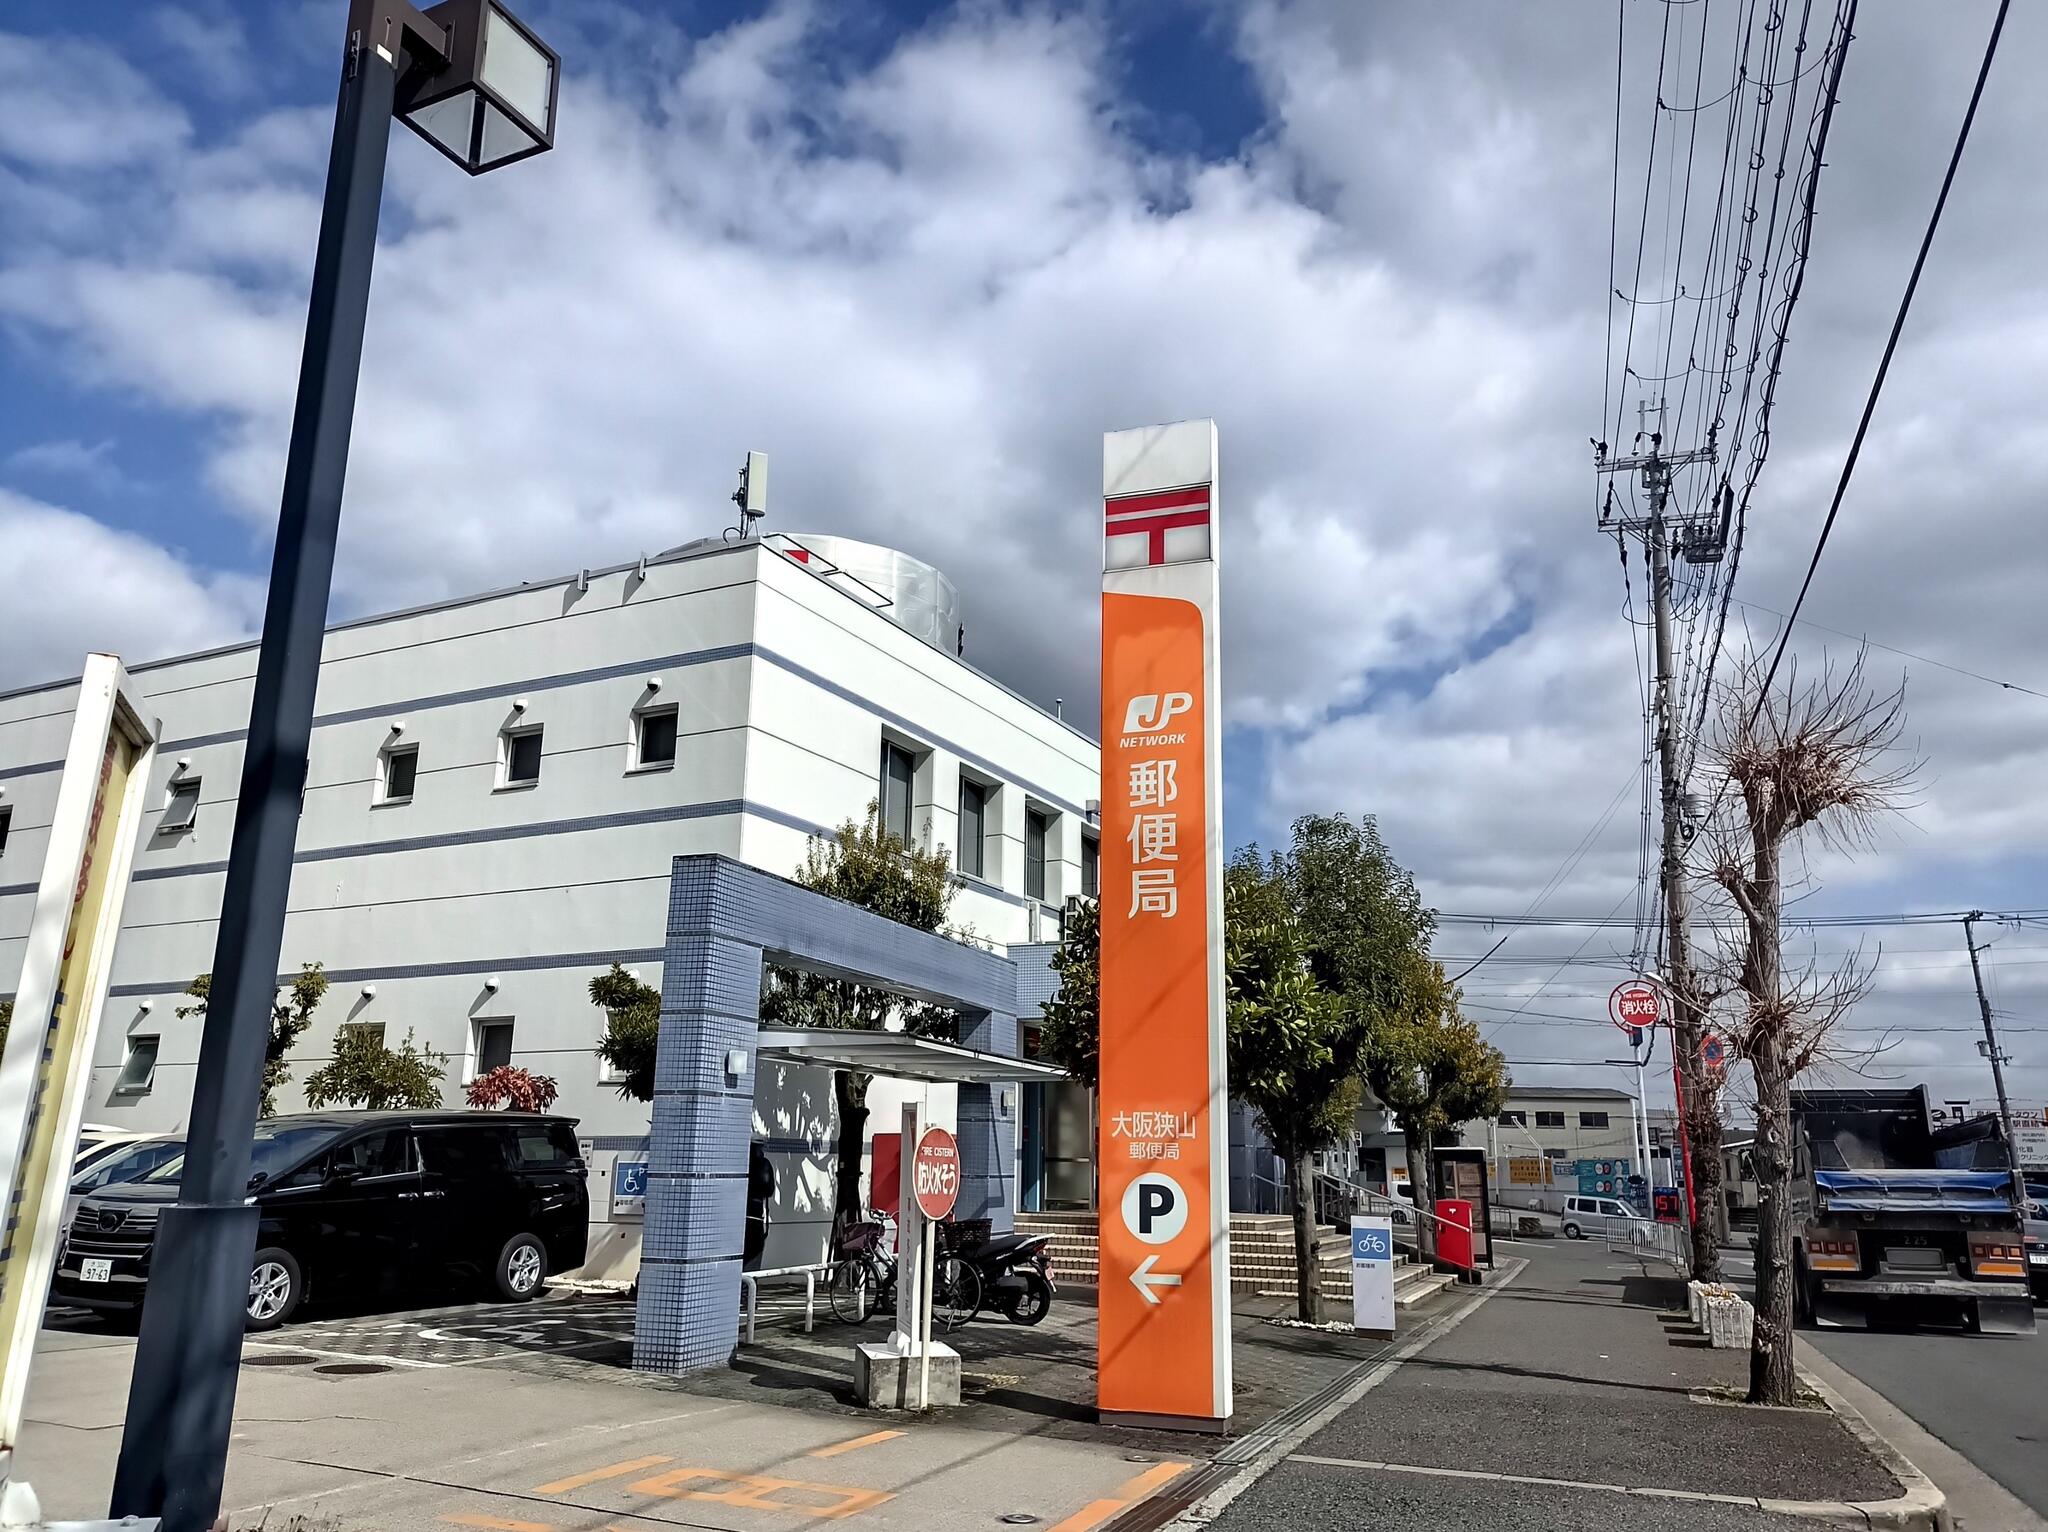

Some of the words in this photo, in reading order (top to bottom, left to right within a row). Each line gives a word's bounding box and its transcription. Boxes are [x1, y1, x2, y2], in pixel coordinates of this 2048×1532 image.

[1123, 692, 1193, 734] JP
[1120, 733, 1187, 749] NETWORK
[1127, 759, 1179, 920] 郵便局
[1621, 1000, 1656, 1015] 消火栓
[1111, 1110, 1196, 1139] 大阪狭山
[921, 1146, 933, 1156] FIRE
[934, 1147, 955, 1158] CISTERN
[1129, 1142, 1180, 1160] 郵便局
[638, 1167, 645, 1177] P
[918, 1162, 956, 1195] 防火水そう
[1138, 1183, 1175, 1234] P
[1655, 1195, 1679, 1211] 157
[85, 1268, 108, 1281] 97-63
